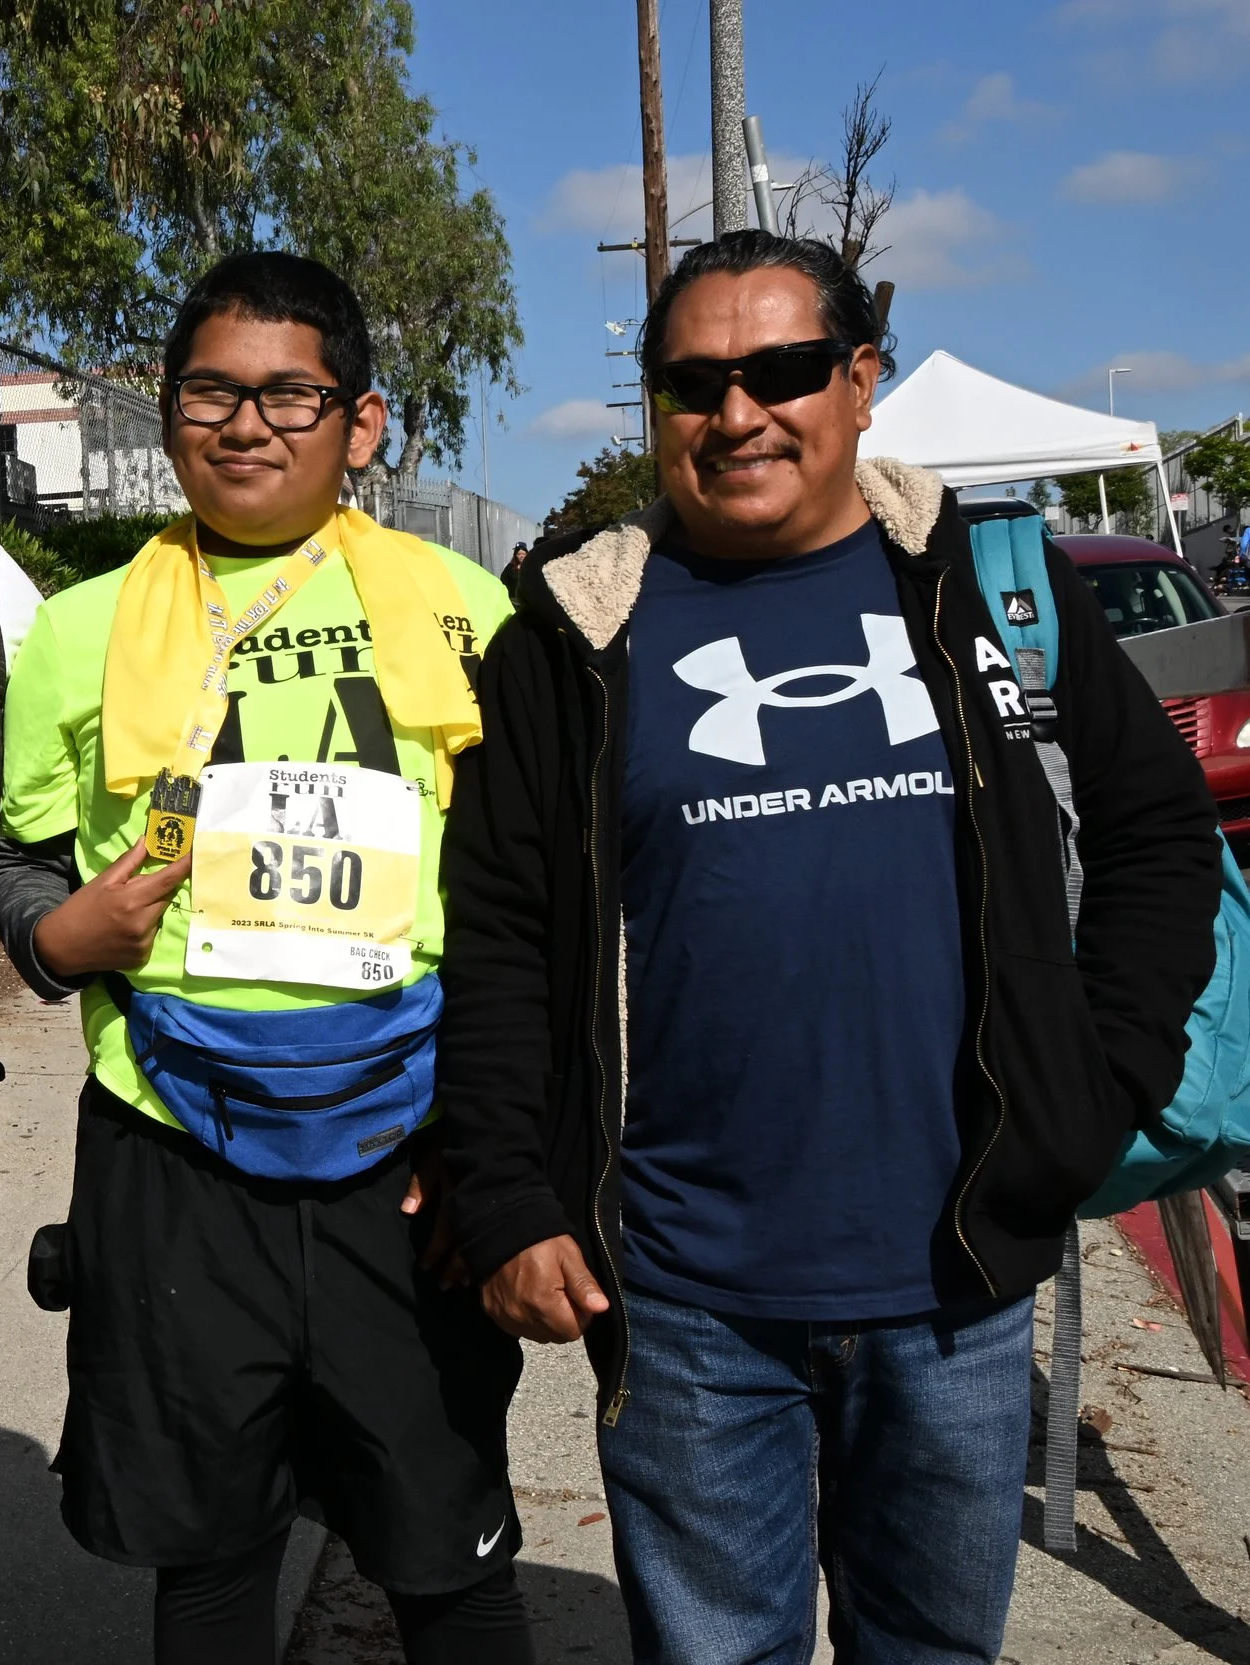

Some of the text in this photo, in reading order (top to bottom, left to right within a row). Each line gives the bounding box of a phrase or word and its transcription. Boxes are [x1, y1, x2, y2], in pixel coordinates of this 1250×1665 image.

[1006, 730, 1030, 741] NEW
[269, 770, 347, 785] Students
[271, 782, 346, 798] run
[269, 793, 344, 840] LA
[681, 788, 812, 826] UNDER
[249, 840, 362, 910] 850
[254, 920, 276, 928] SRLA
[279, 921, 306, 932] Spring
[309, 924, 324, 933] Into
[327, 928, 360, 938] Summer
[364, 931, 374, 939] 5K
[350, 947, 390, 961] BAG CHECK
[361, 961, 394, 981] 850
